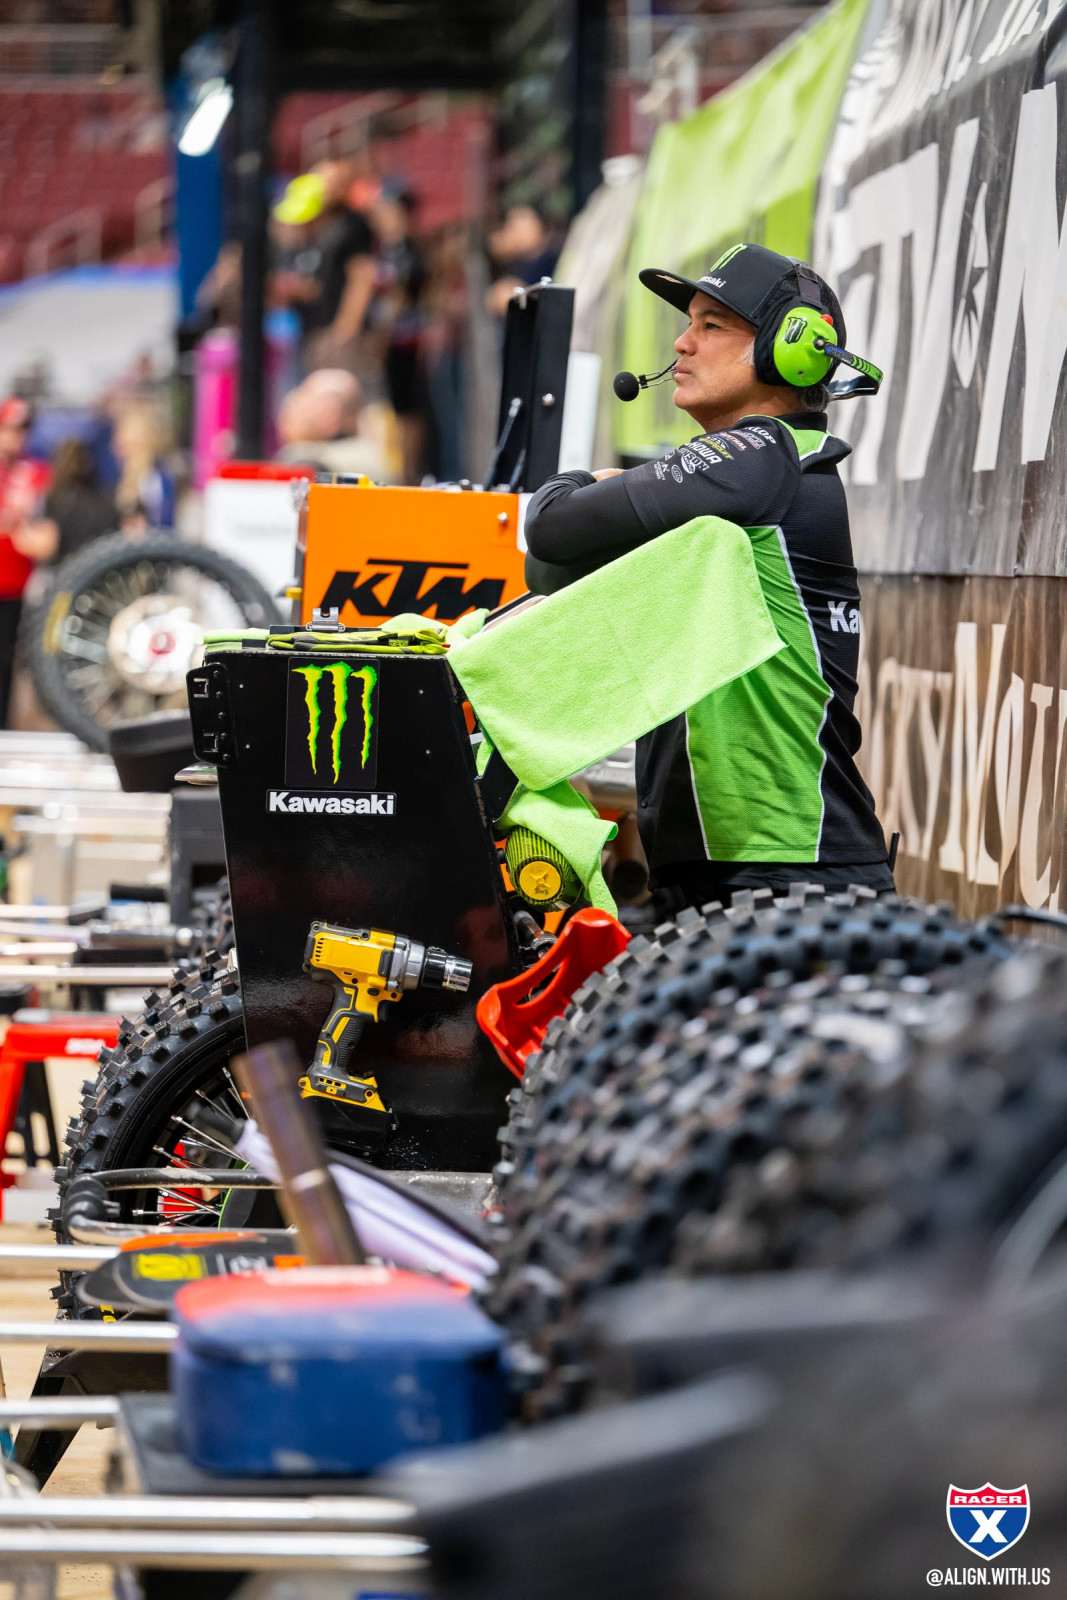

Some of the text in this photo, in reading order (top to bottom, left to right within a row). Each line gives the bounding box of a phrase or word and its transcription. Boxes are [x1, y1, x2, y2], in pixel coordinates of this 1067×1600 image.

[698, 276, 727, 288] saki
[318, 558, 507, 621] KTM
[269, 790, 395, 815] Kawasaki
